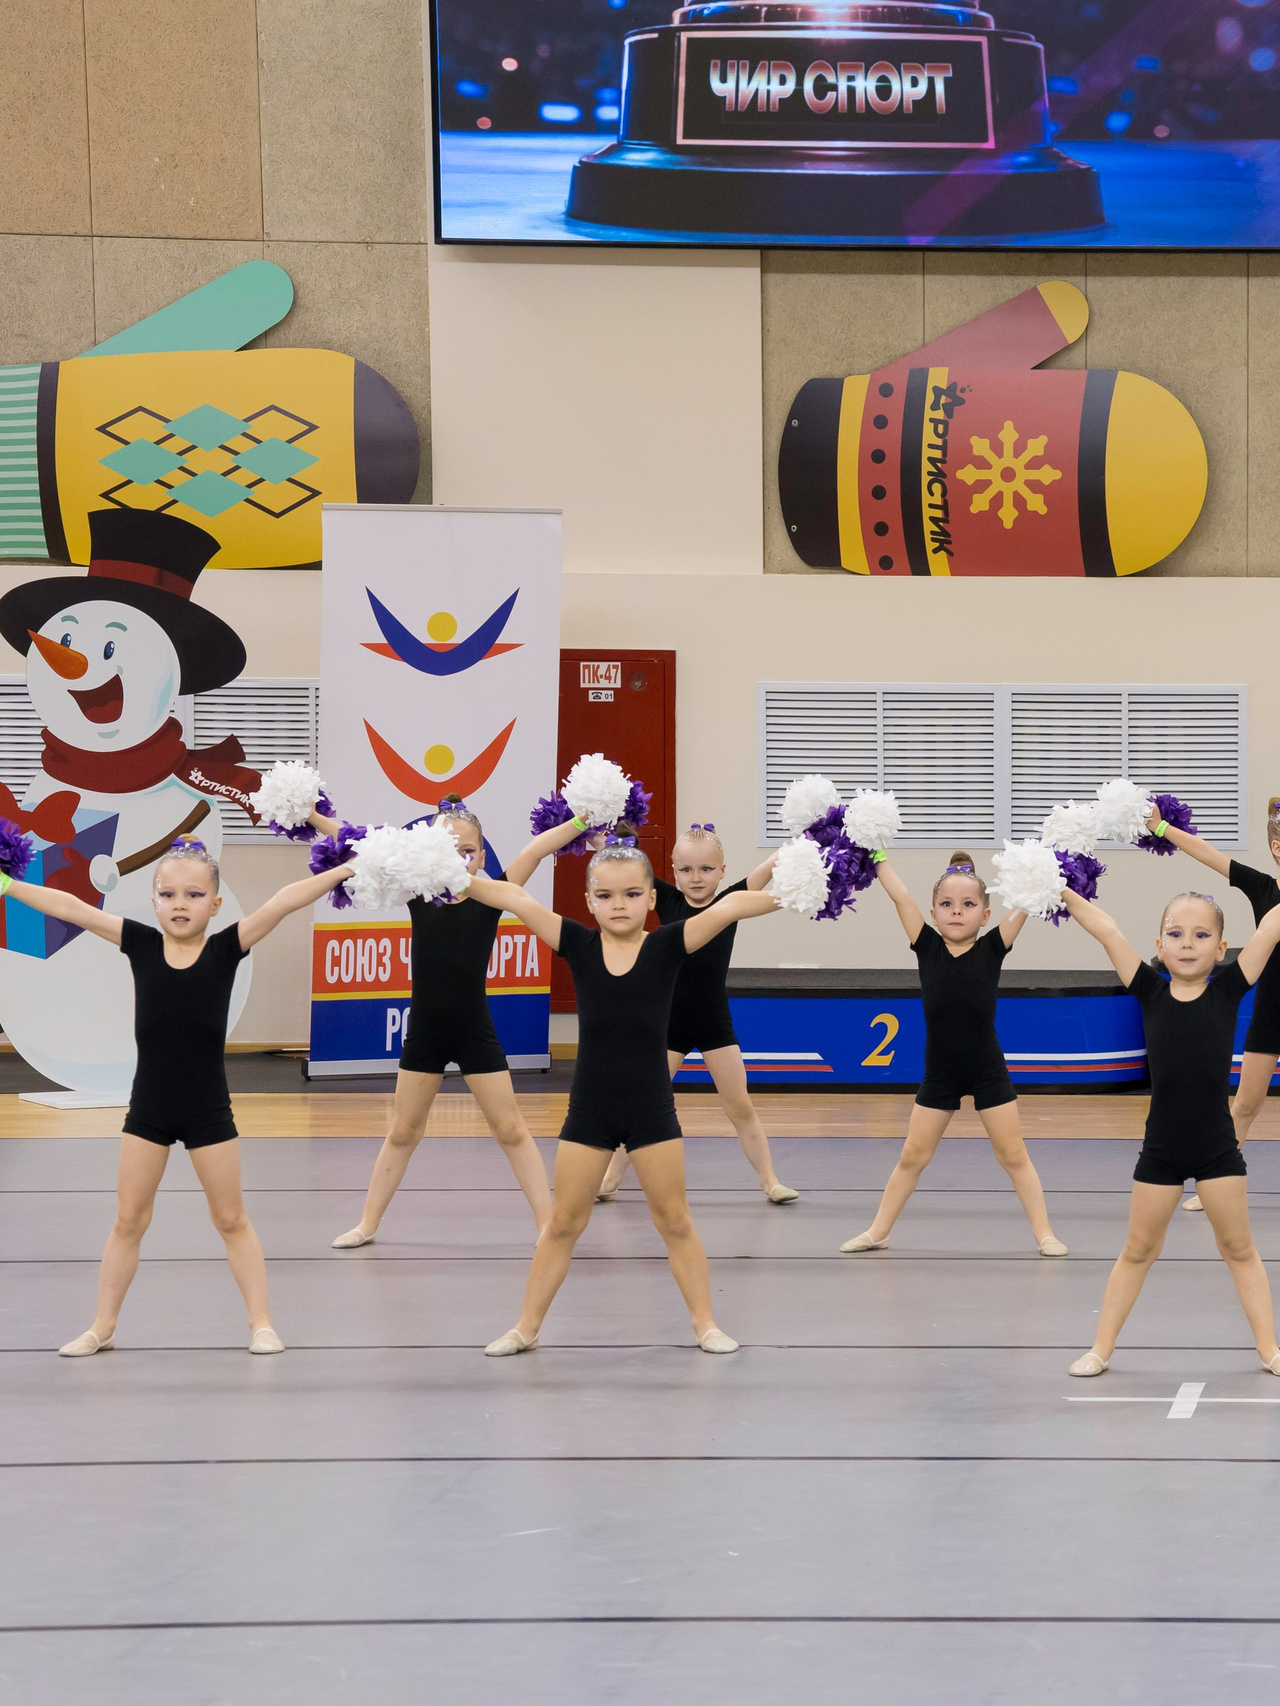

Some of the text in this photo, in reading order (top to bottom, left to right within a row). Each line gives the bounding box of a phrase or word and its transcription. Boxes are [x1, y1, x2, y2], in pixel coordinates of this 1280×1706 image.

[709, 60, 953, 114] ЧИР СПОРТ
[582, 664, 620, 684] ПК-47
[325, 937, 392, 984] СОЮЗ
[861, 1013, 899, 1066] 2
